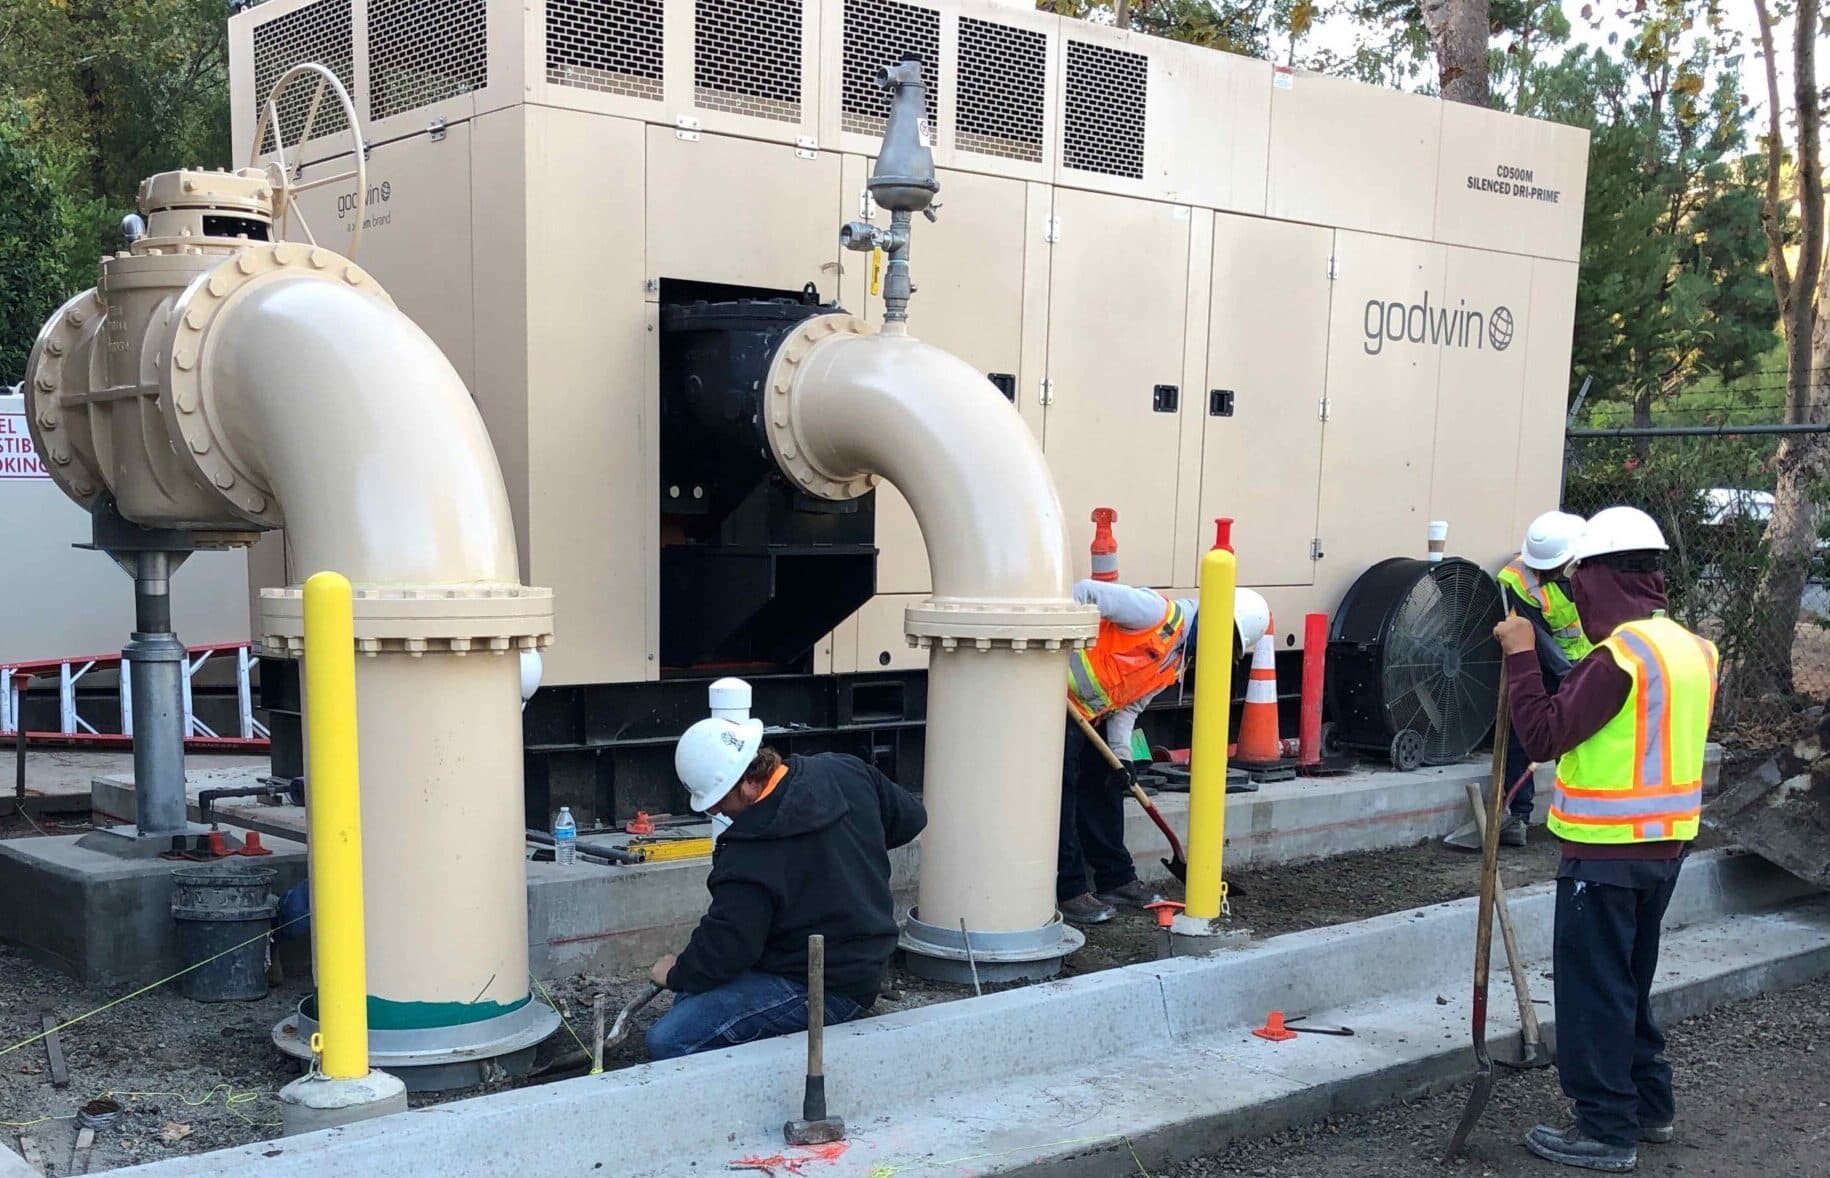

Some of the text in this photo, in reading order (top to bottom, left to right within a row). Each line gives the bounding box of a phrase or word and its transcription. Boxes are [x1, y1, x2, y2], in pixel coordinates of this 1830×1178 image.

[1497, 165, 1533, 182] CD500M
[338, 184, 380, 219] goin
[1467, 176, 1560, 203] SILENCED DRI-PRIME
[1364, 290, 1484, 355] godwin
